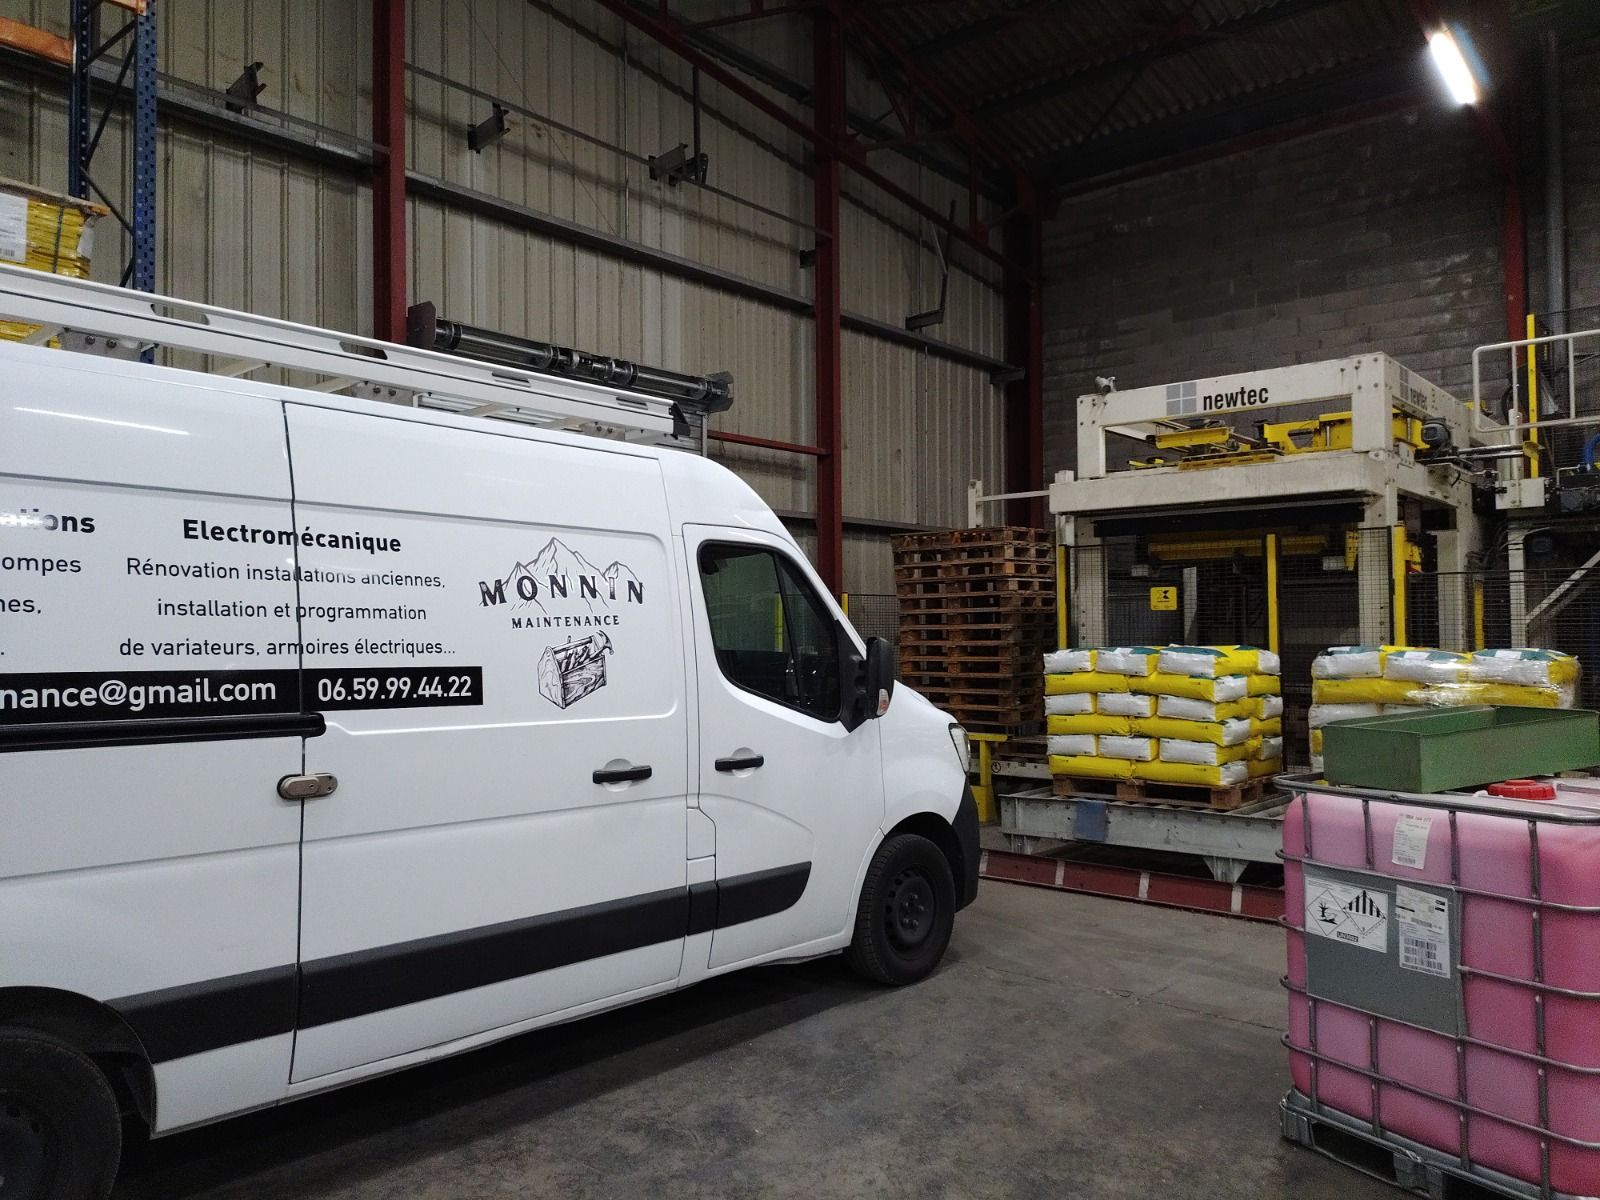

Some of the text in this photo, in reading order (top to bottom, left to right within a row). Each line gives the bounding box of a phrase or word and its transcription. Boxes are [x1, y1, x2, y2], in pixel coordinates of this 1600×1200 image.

[1203, 387, 1269, 411] newtec
[183, 518, 402, 555] Electromécanique
[1, 556, 82, 577] ompes
[127, 557, 446, 588] Rénovation installations anciennes,
[478, 574, 644, 607] MONNIN
[157, 598, 427, 623] installation et programmation
[511, 615, 620, 629] MAINTENANCE
[119, 638, 456, 658] de variateurs, armoires électriques...
[0, 675, 472, 712] nance@gmail.com 06.59.99.44.22
